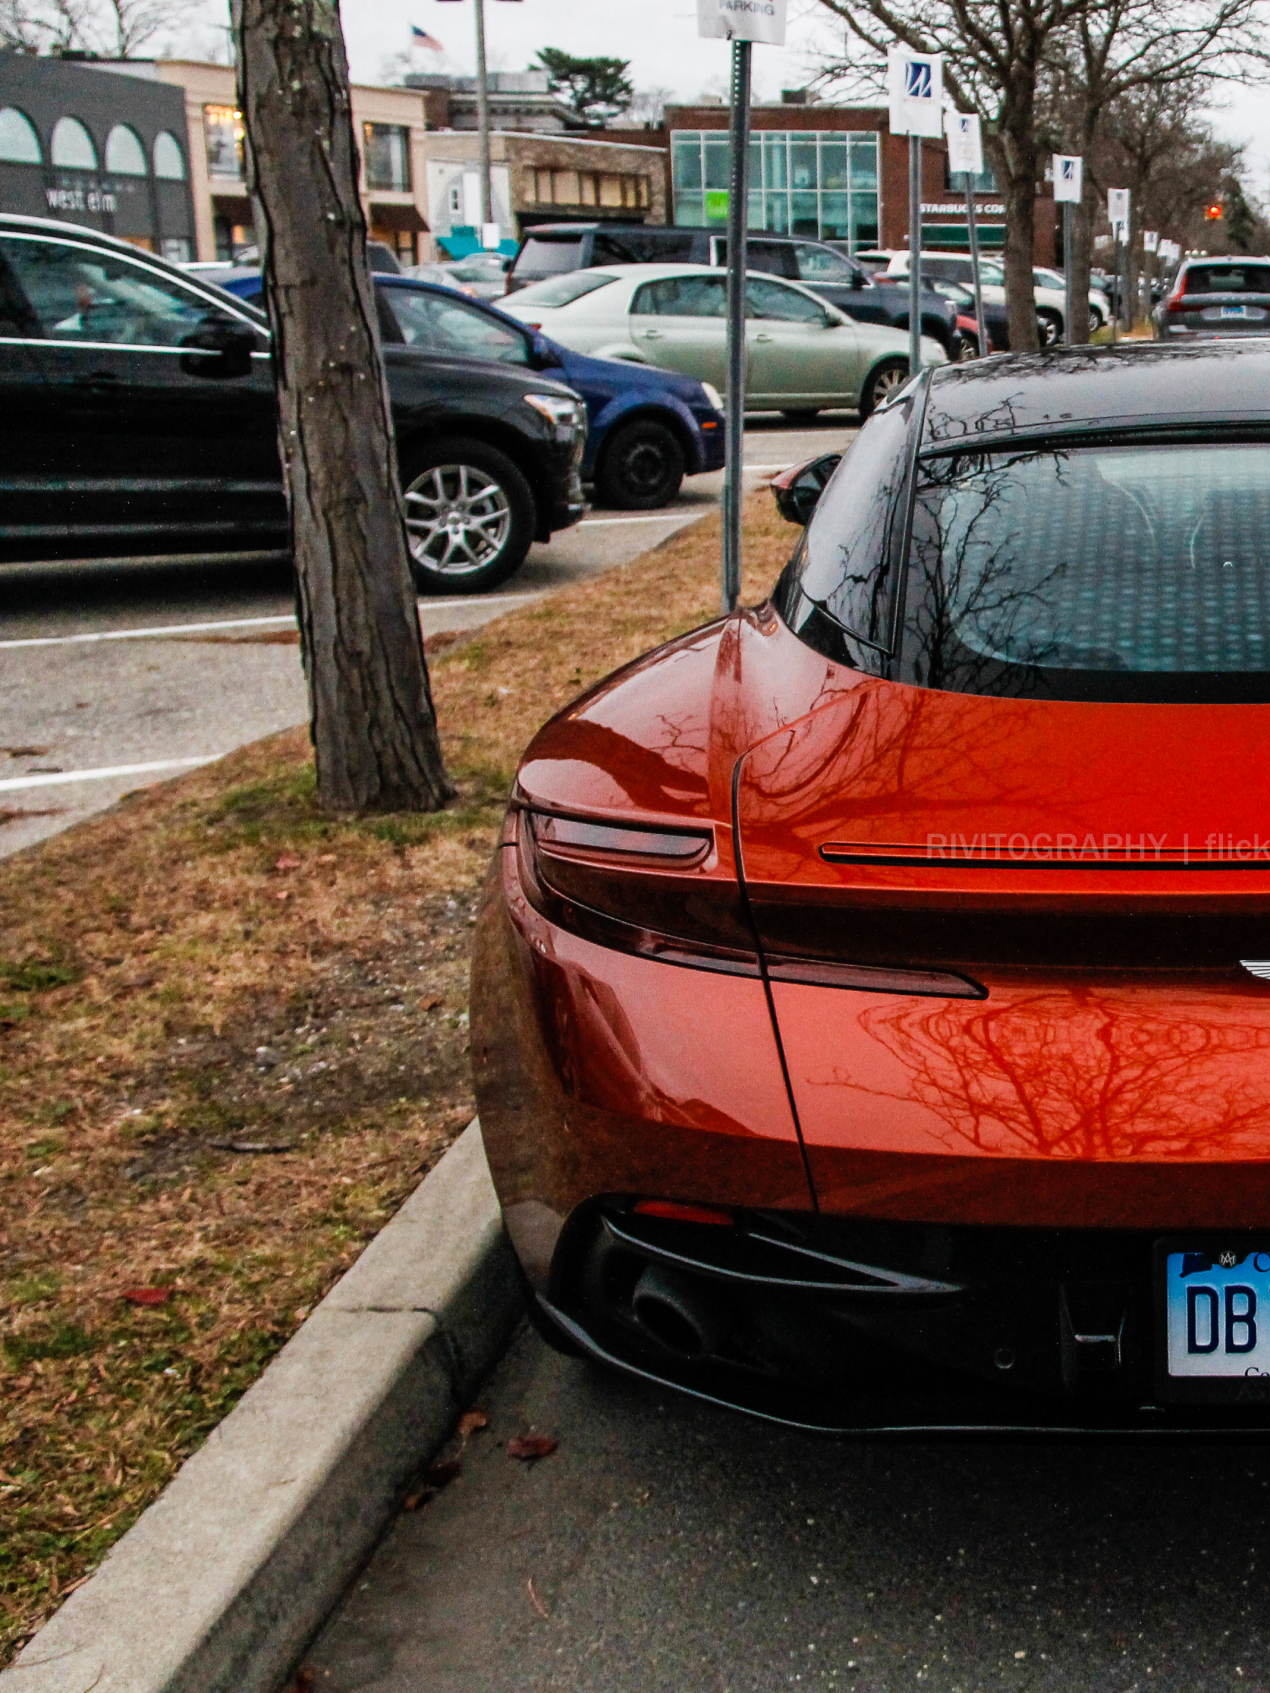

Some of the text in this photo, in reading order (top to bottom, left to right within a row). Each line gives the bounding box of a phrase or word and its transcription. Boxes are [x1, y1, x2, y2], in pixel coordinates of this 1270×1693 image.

[720, 0, 774, 15] PARKING
[46, 189, 117, 212] west elm
[919, 203, 983, 214] STARBUCS
